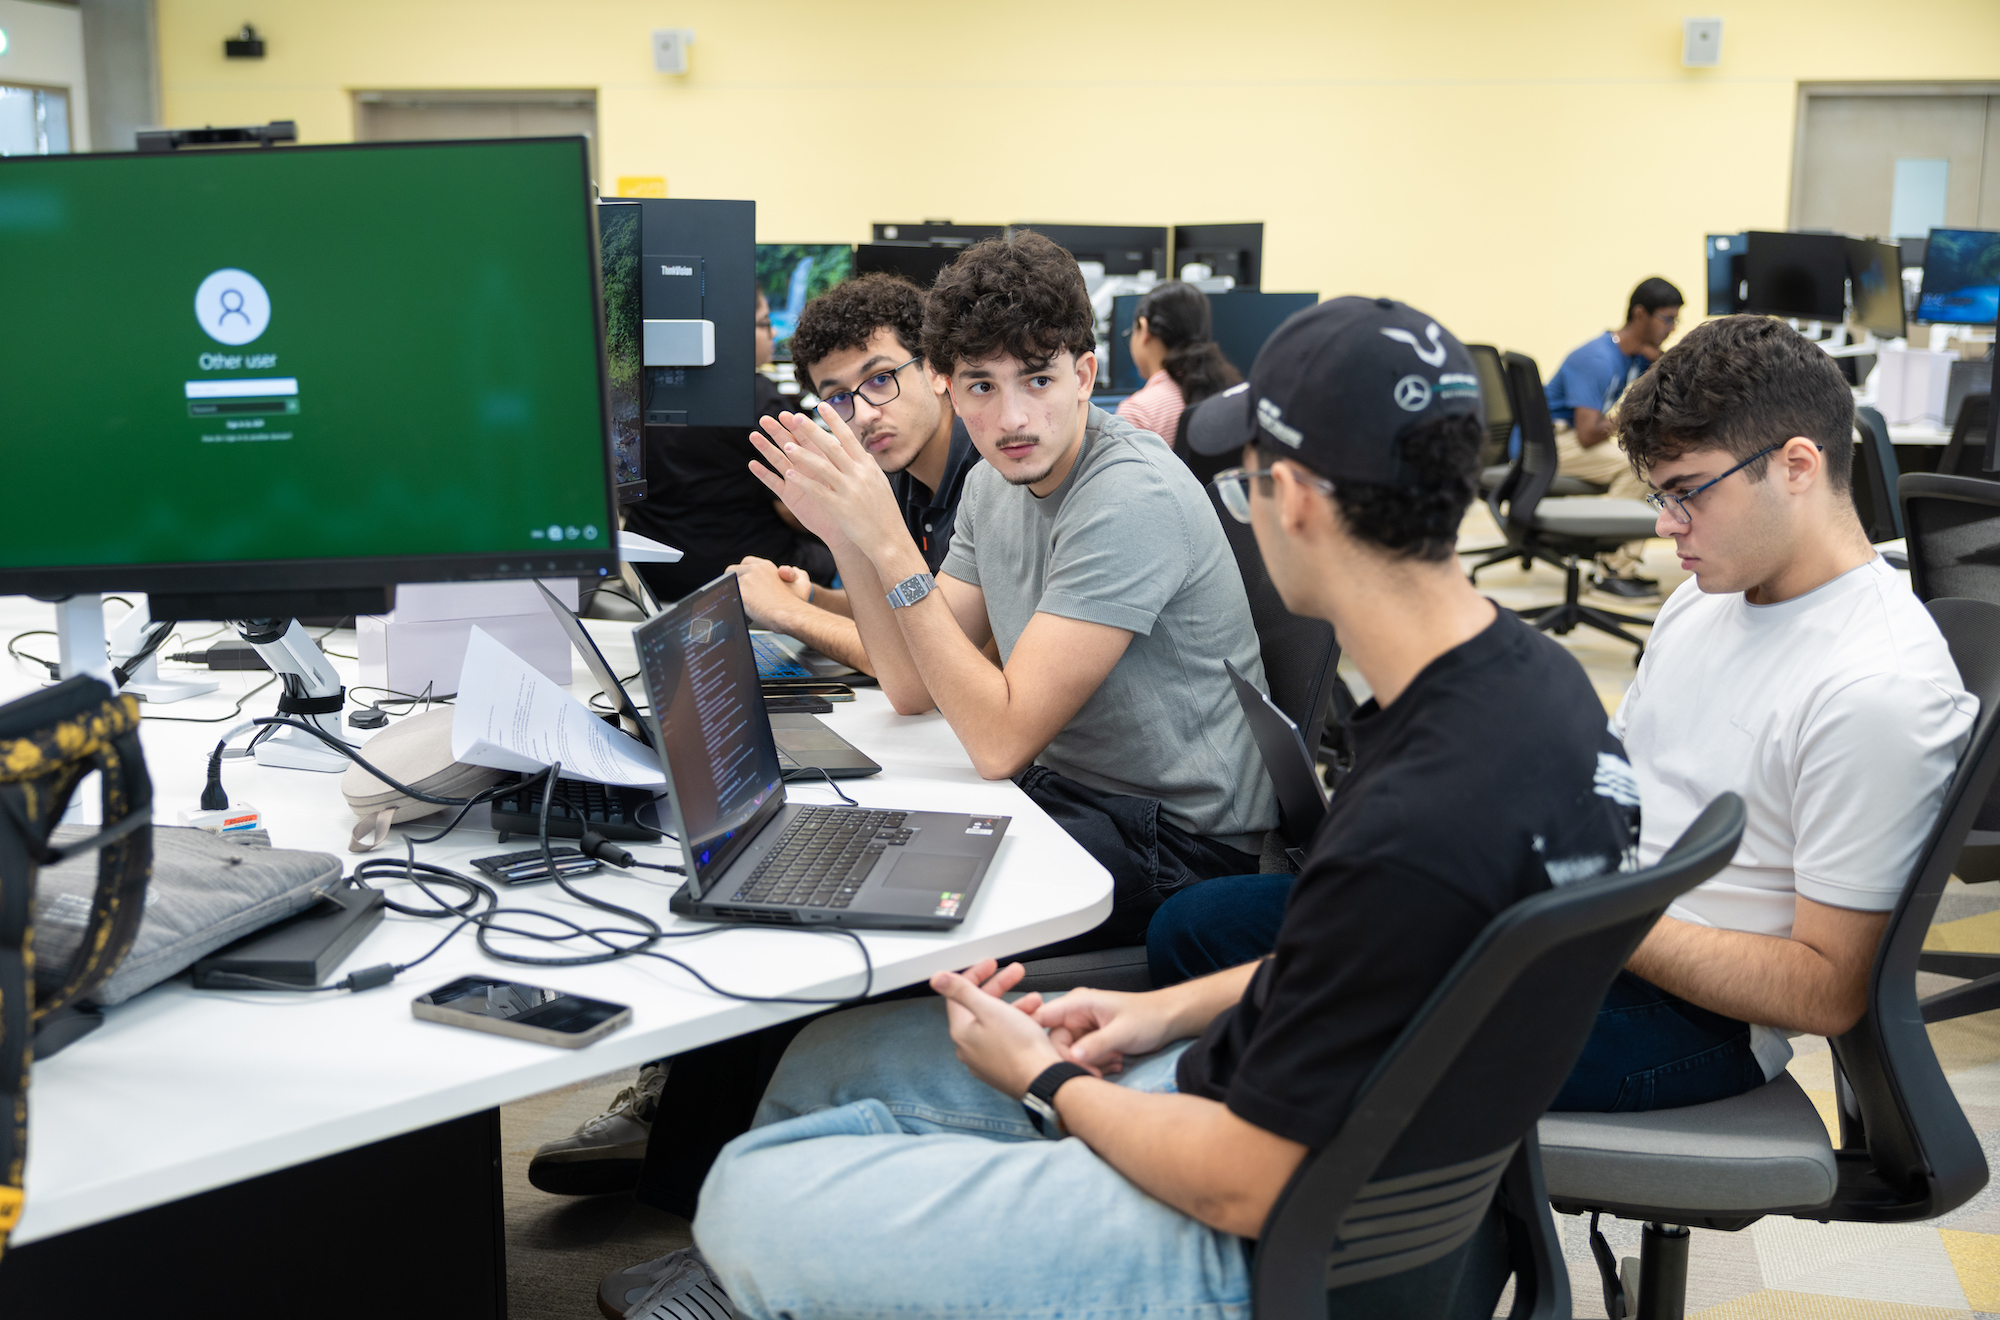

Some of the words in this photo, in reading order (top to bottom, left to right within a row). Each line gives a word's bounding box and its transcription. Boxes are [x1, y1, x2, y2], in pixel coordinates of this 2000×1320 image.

[661, 265, 693, 276] ThinkVision
[199, 352, 242, 370] Other
[245, 353, 277, 369] user
